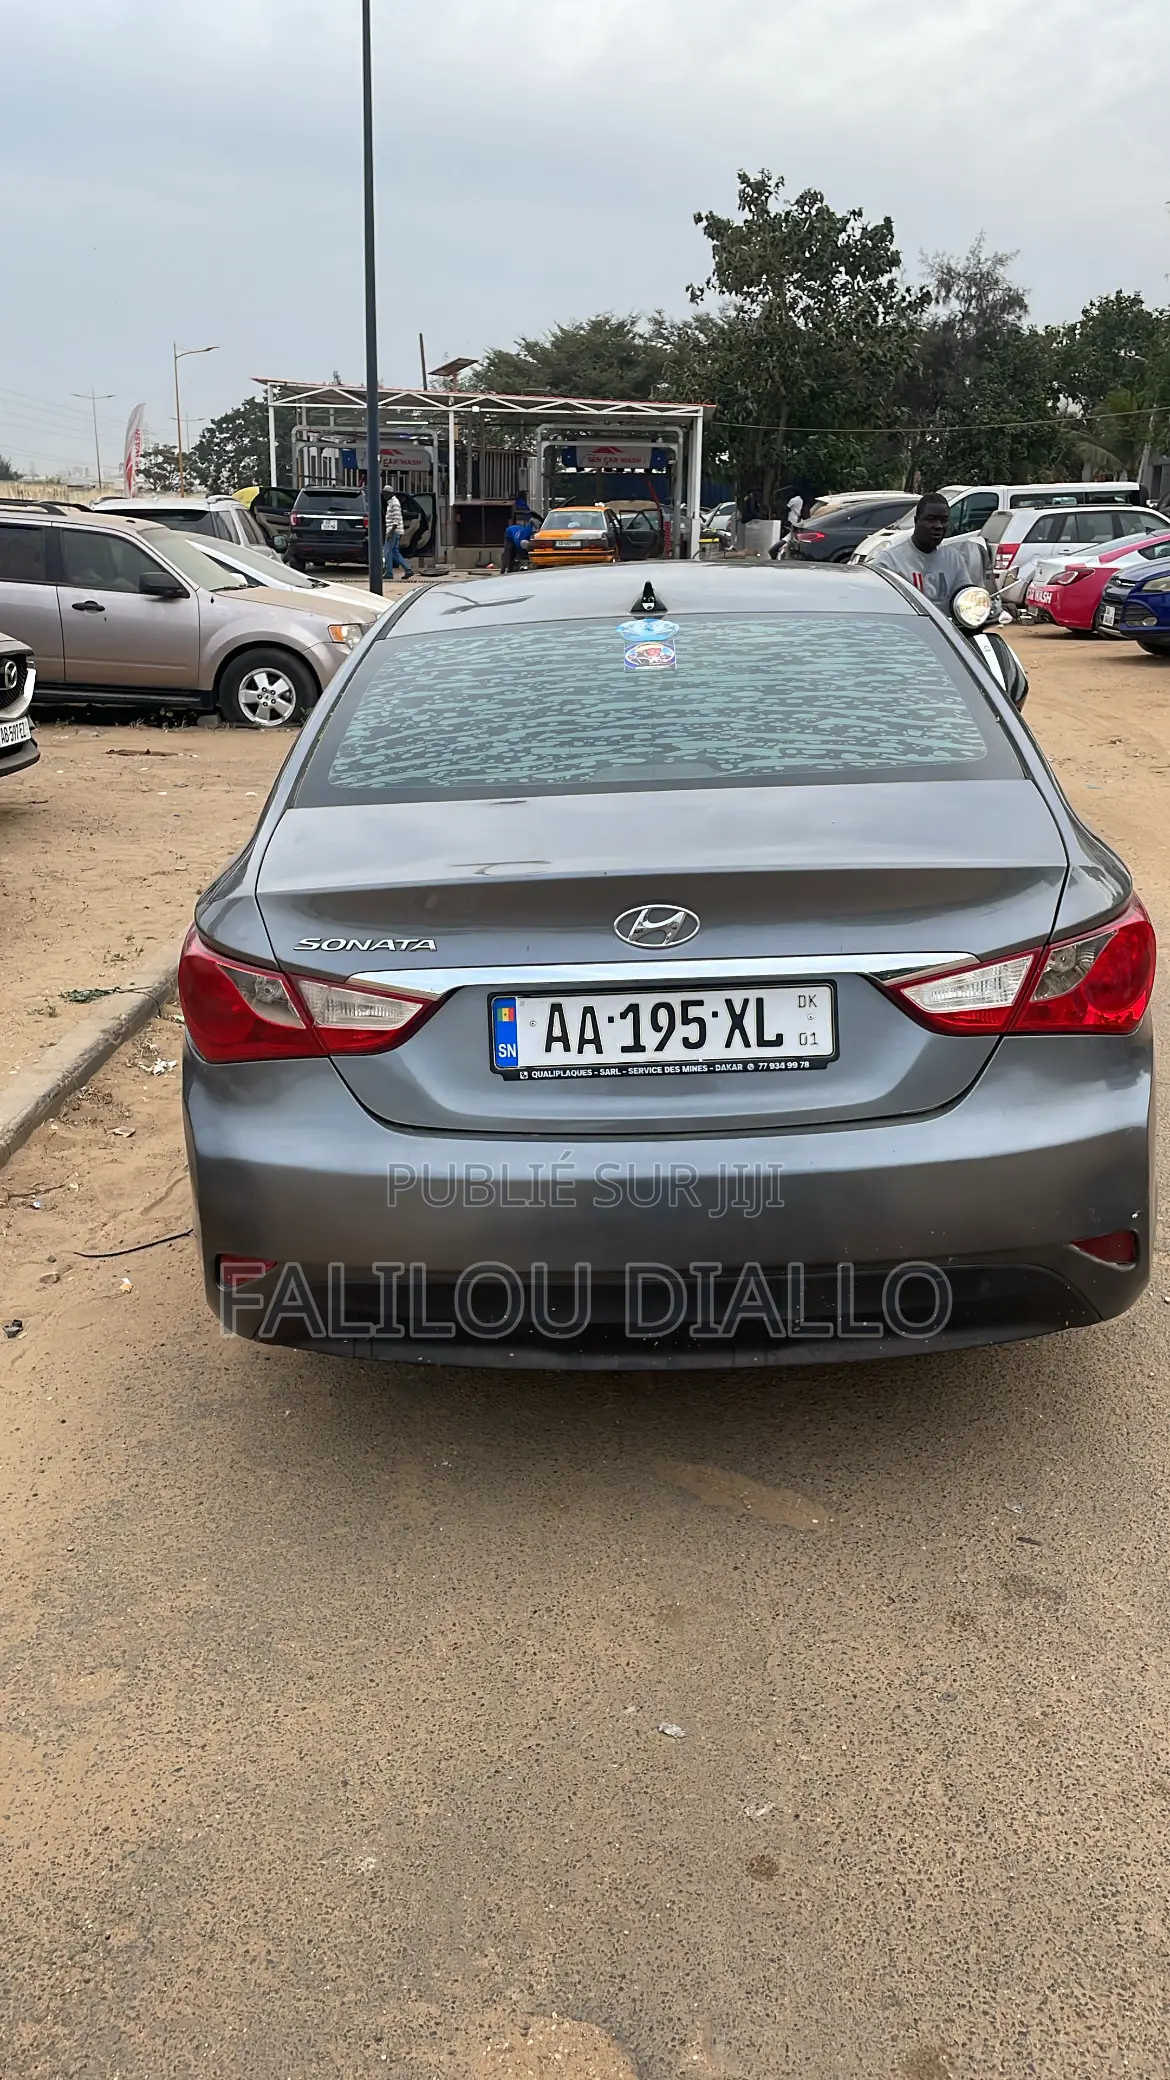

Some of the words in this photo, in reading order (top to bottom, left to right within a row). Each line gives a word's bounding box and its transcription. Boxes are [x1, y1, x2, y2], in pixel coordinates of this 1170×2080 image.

[1035, 591, 1053, 605] WASH
[293, 938, 438, 953] SONATA
[797, 994, 817, 1008] DK
[799, 1032, 819, 1046] 01
[498, 1043, 517, 1058] SN
[531, 1068, 593, 1079] QUALIPLAQUES
[600, 1068, 621, 1076] SARL
[628, 1067, 663, 1075] SERVICE
[664, 1066, 681, 1074] DES
[682, 1065, 708, 1073] MINES
[715, 1063, 743, 1071] DAKAR
